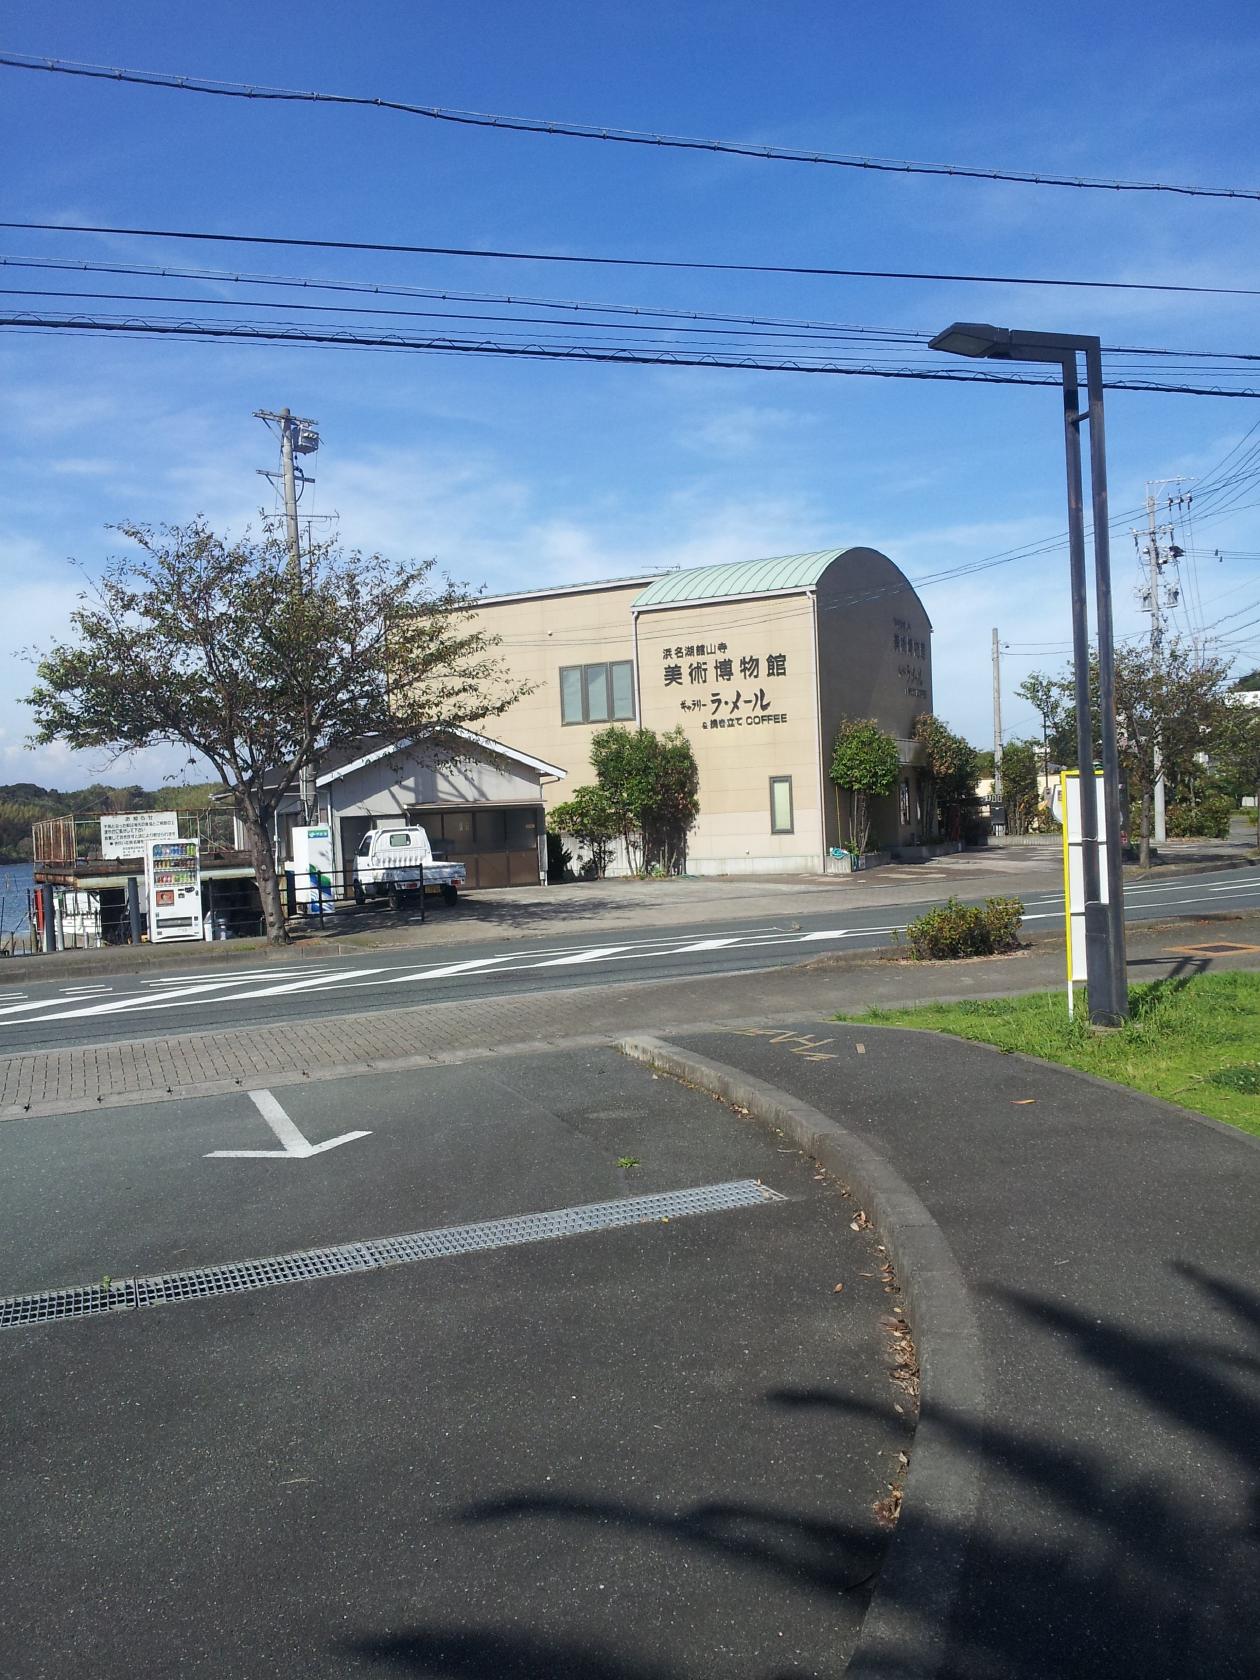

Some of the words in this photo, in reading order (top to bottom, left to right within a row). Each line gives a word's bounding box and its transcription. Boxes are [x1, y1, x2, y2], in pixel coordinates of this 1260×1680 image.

[663, 653, 787, 687] 美術博物館
[680, 699, 707, 713] ギャラリー
[710, 688, 771, 716] ラ・メール
[745, 713, 787, 726] COFFEE
